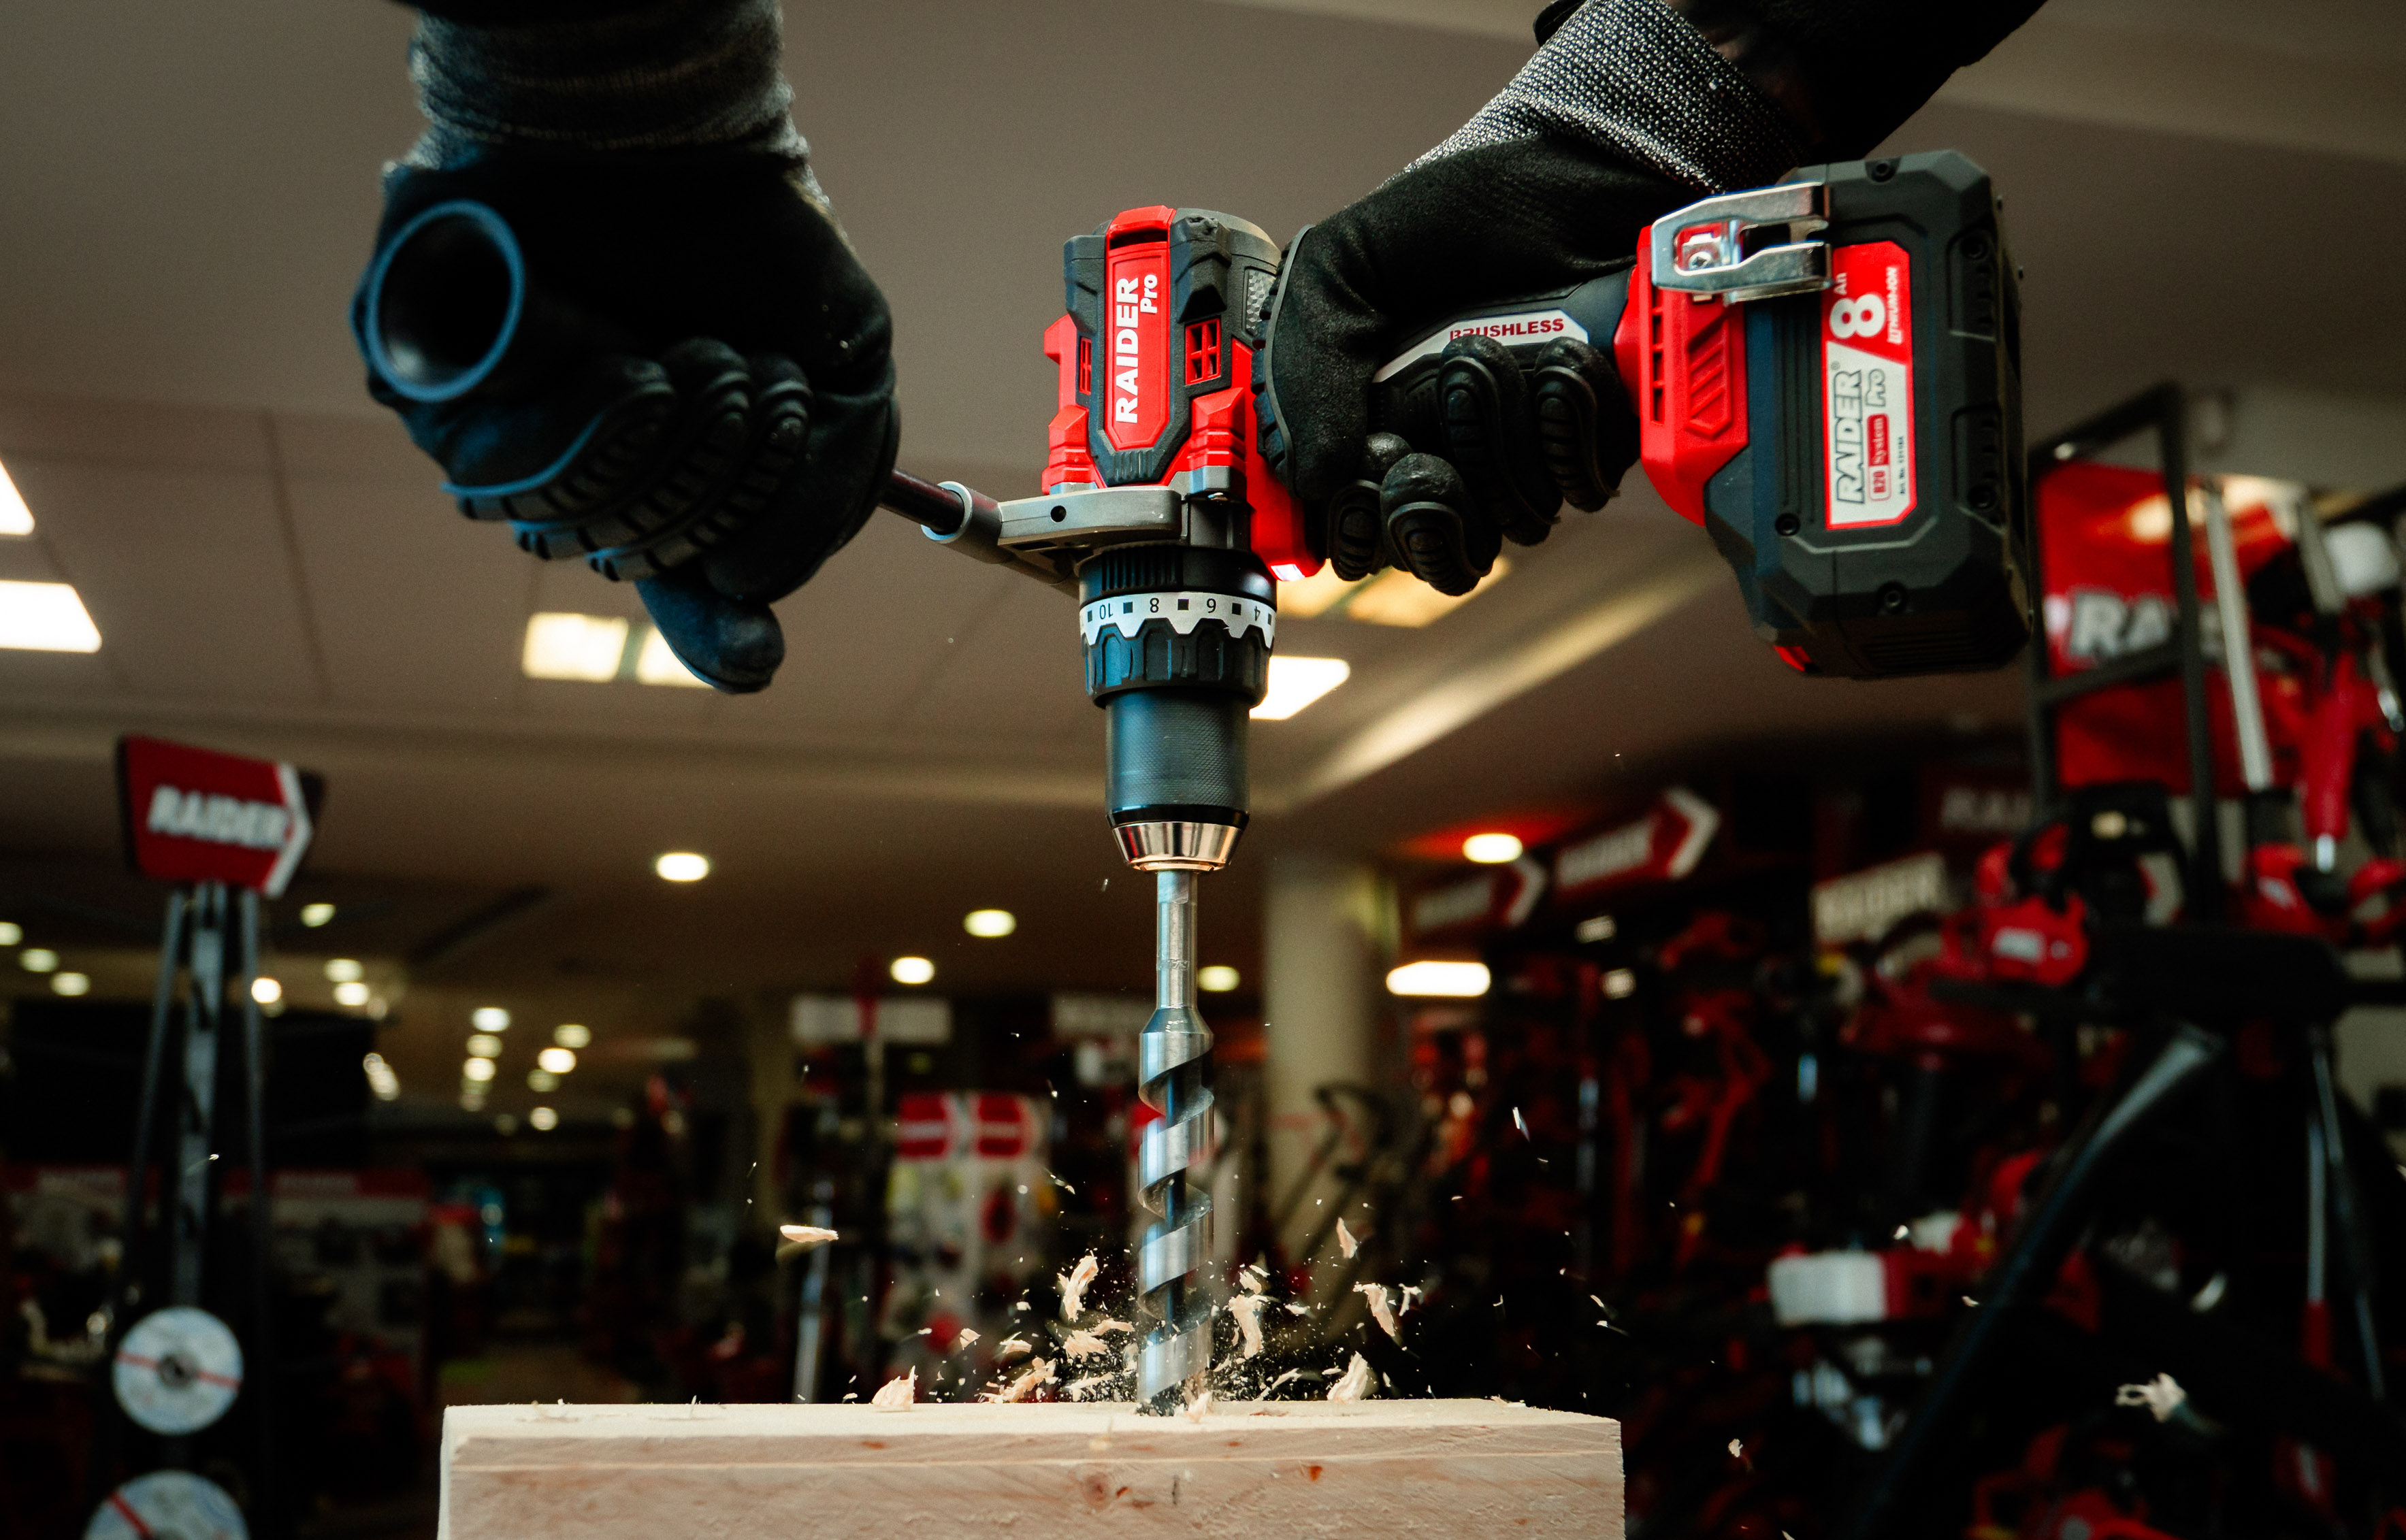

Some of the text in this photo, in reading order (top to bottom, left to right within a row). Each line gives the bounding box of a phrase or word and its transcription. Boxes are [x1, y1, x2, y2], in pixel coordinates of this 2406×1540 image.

[1139, 274, 1158, 314] Pro
[1830, 293, 1885, 339] 8
[1115, 277, 1139, 424] RAIDER
[1866, 368, 1886, 408] Pro
[1834, 369, 1866, 504] RAIDER
[1872, 416, 1887, 465] System
[1099, 597, 1261, 622] 4 6 8 10
